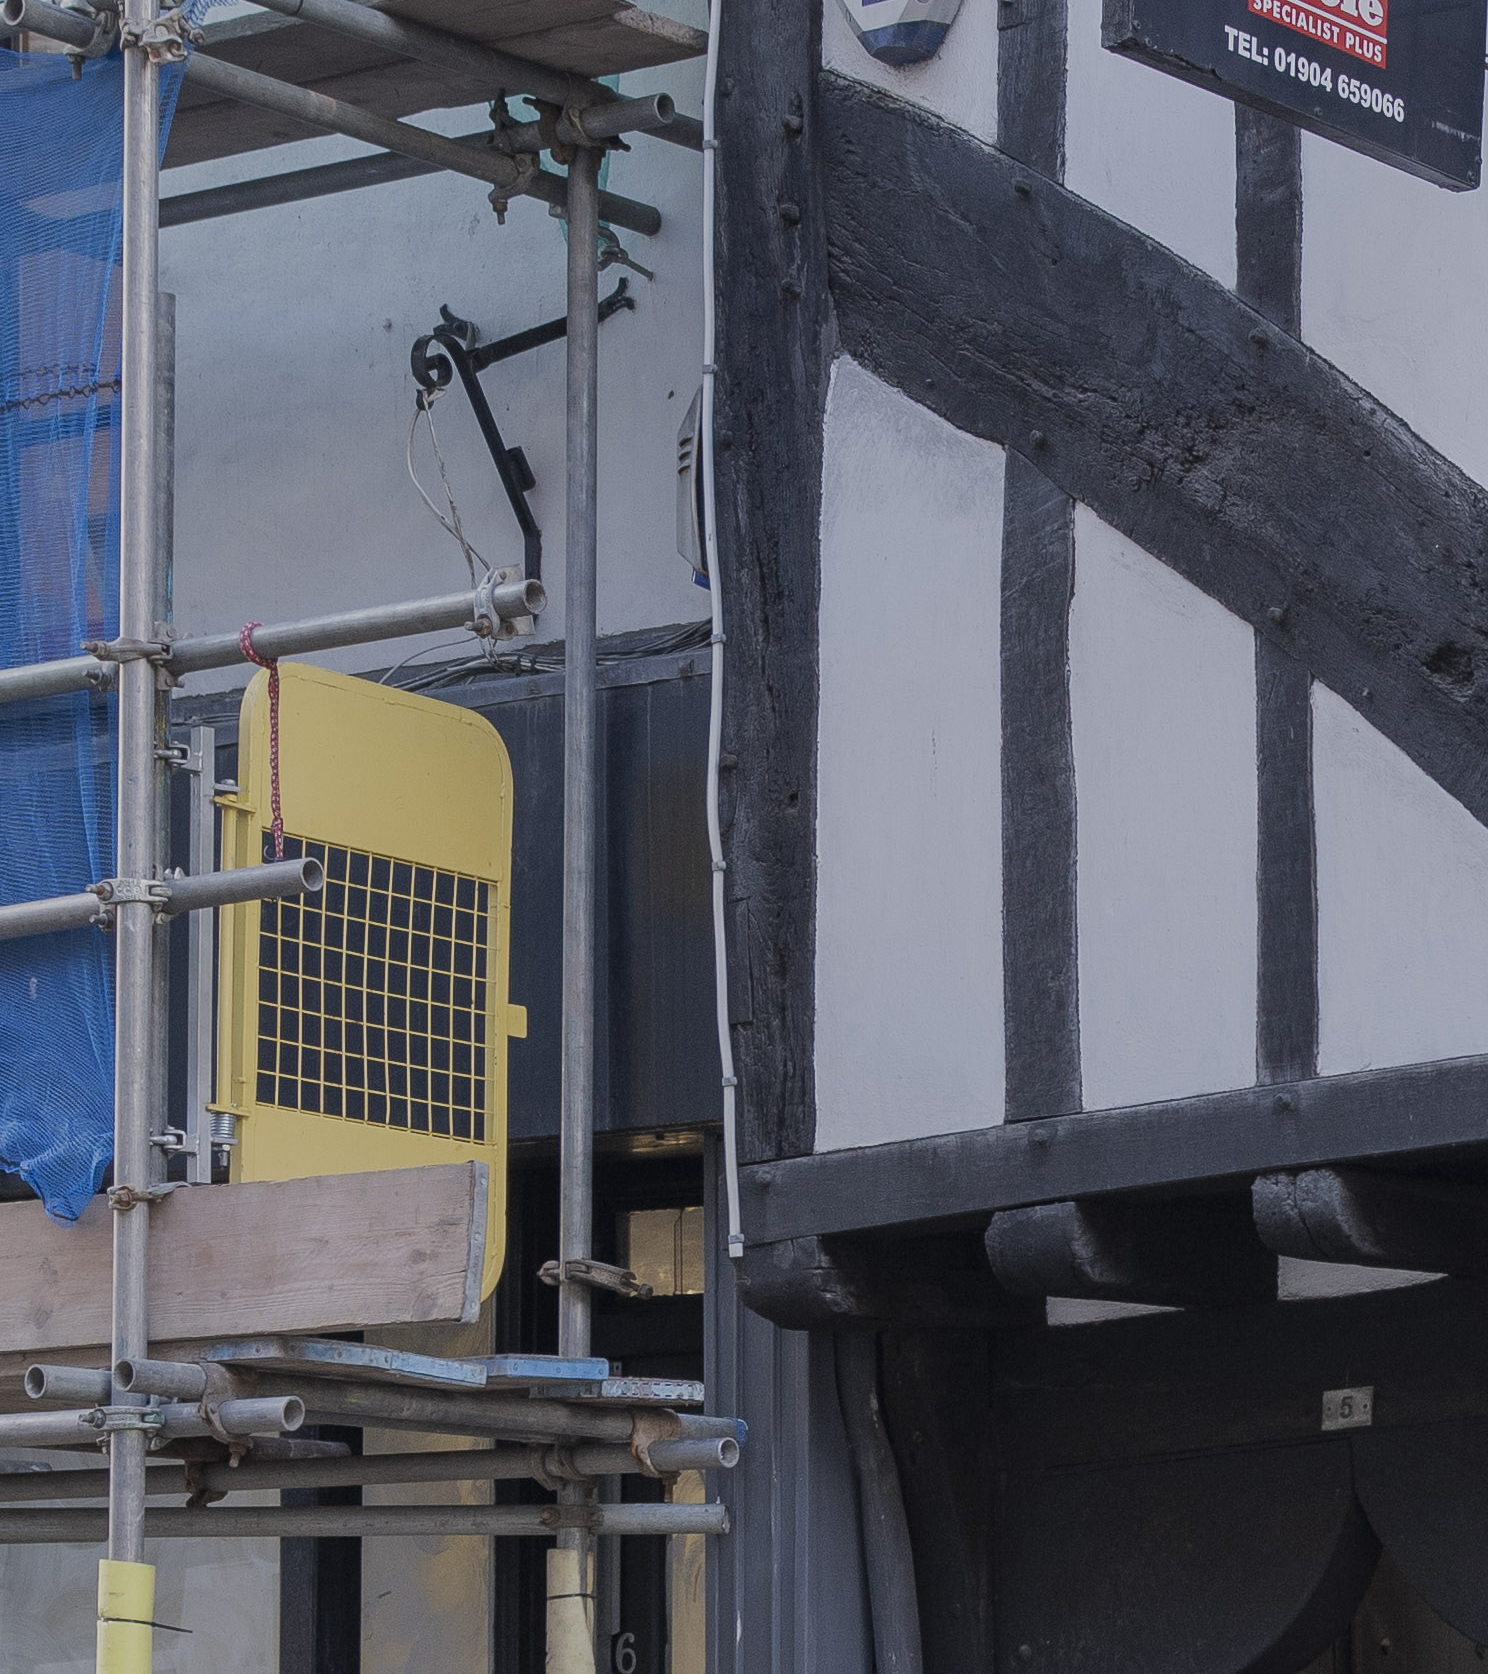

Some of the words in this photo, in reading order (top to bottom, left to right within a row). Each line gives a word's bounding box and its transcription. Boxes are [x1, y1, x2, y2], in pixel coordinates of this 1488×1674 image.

[1346, 29, 1383, 64] PLUS
[1224, 25, 1269, 67] TEL:
[1274, 47, 1333, 92] 01904
[1337, 76, 1405, 123] 659066
[1340, 1395, 1353, 1418] 5
[615, 1632, 637, 1674] 6
